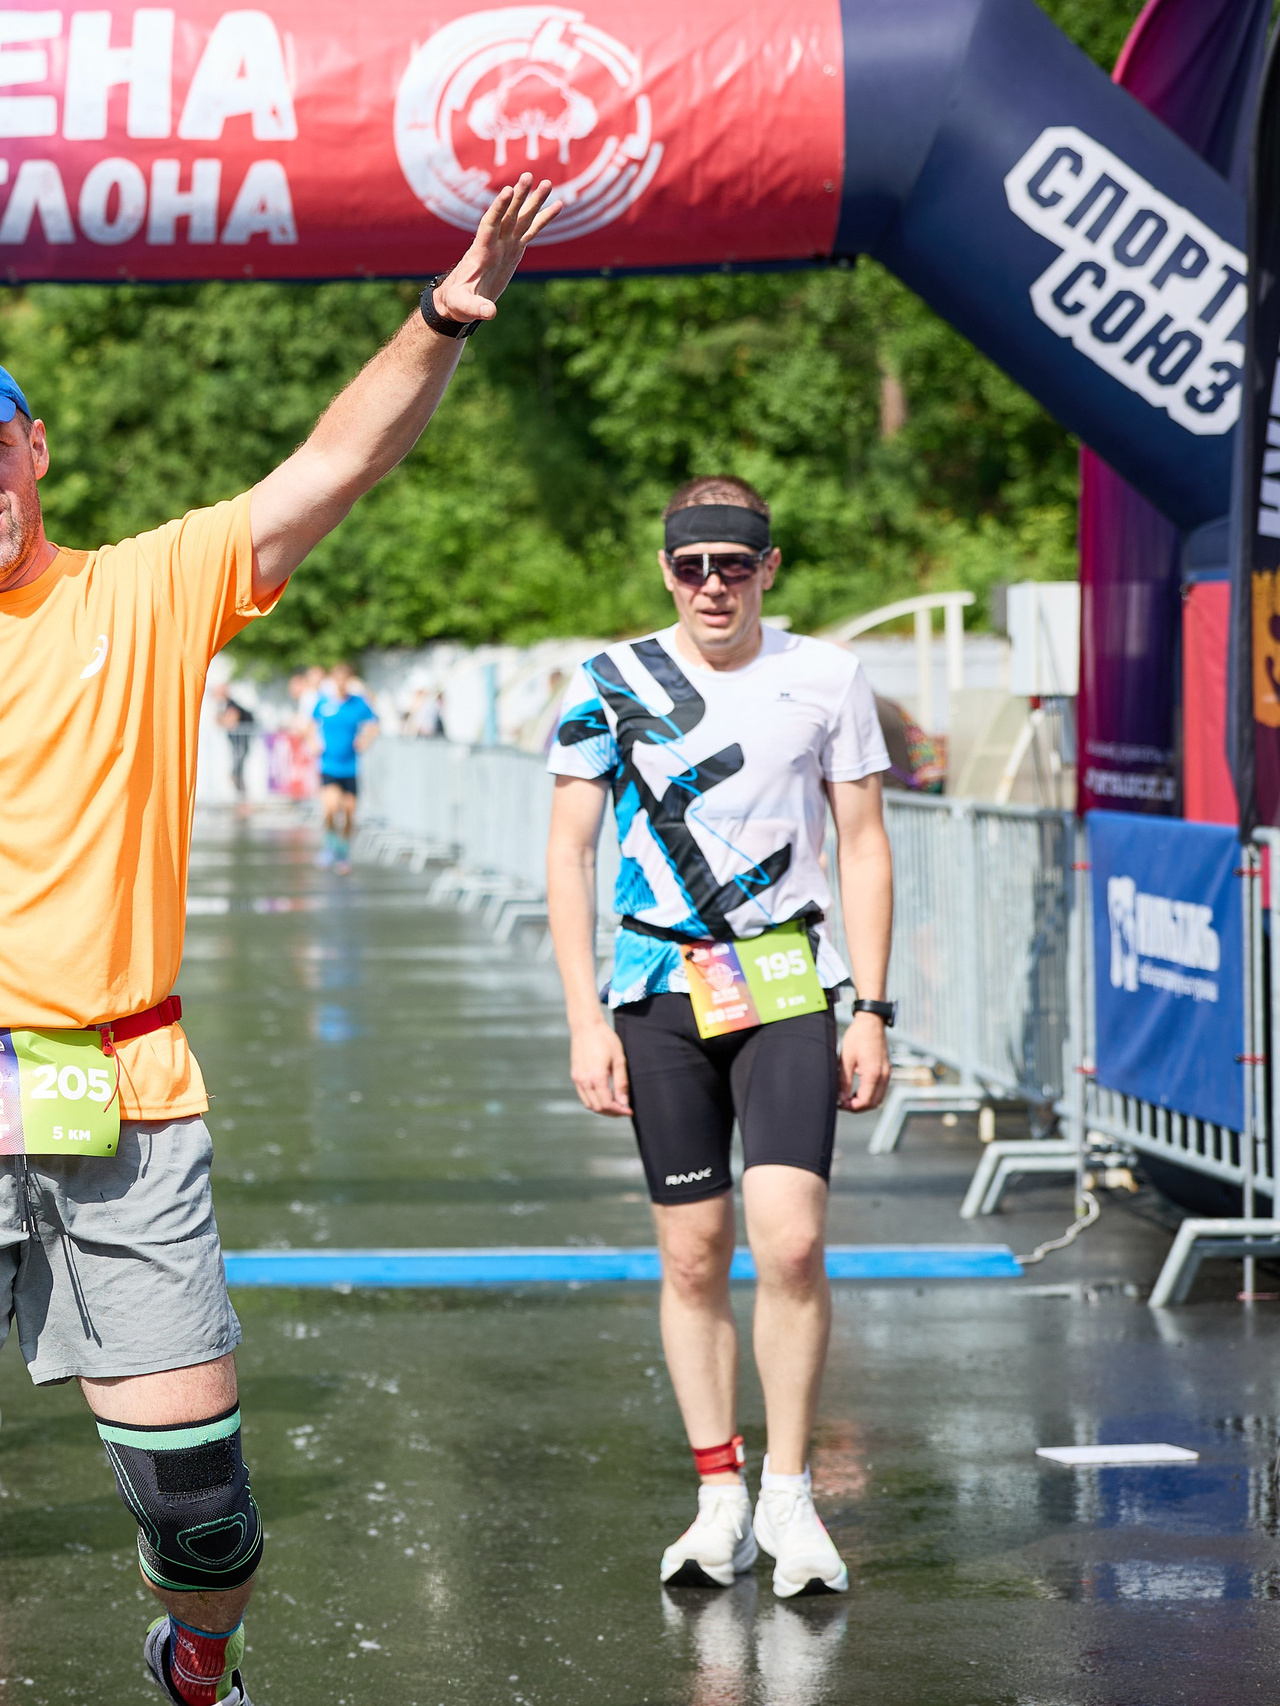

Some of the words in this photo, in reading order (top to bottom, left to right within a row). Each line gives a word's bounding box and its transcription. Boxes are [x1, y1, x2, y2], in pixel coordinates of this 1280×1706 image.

[1027, 147, 1247, 326] СПОРТ
[1051, 261, 1242, 413] СОЮЗ
[754, 949, 808, 982] 195
[30, 1064, 112, 1103] 205
[52, 1126, 64, 1140] 5
[68, 1129, 91, 1141] КМ
